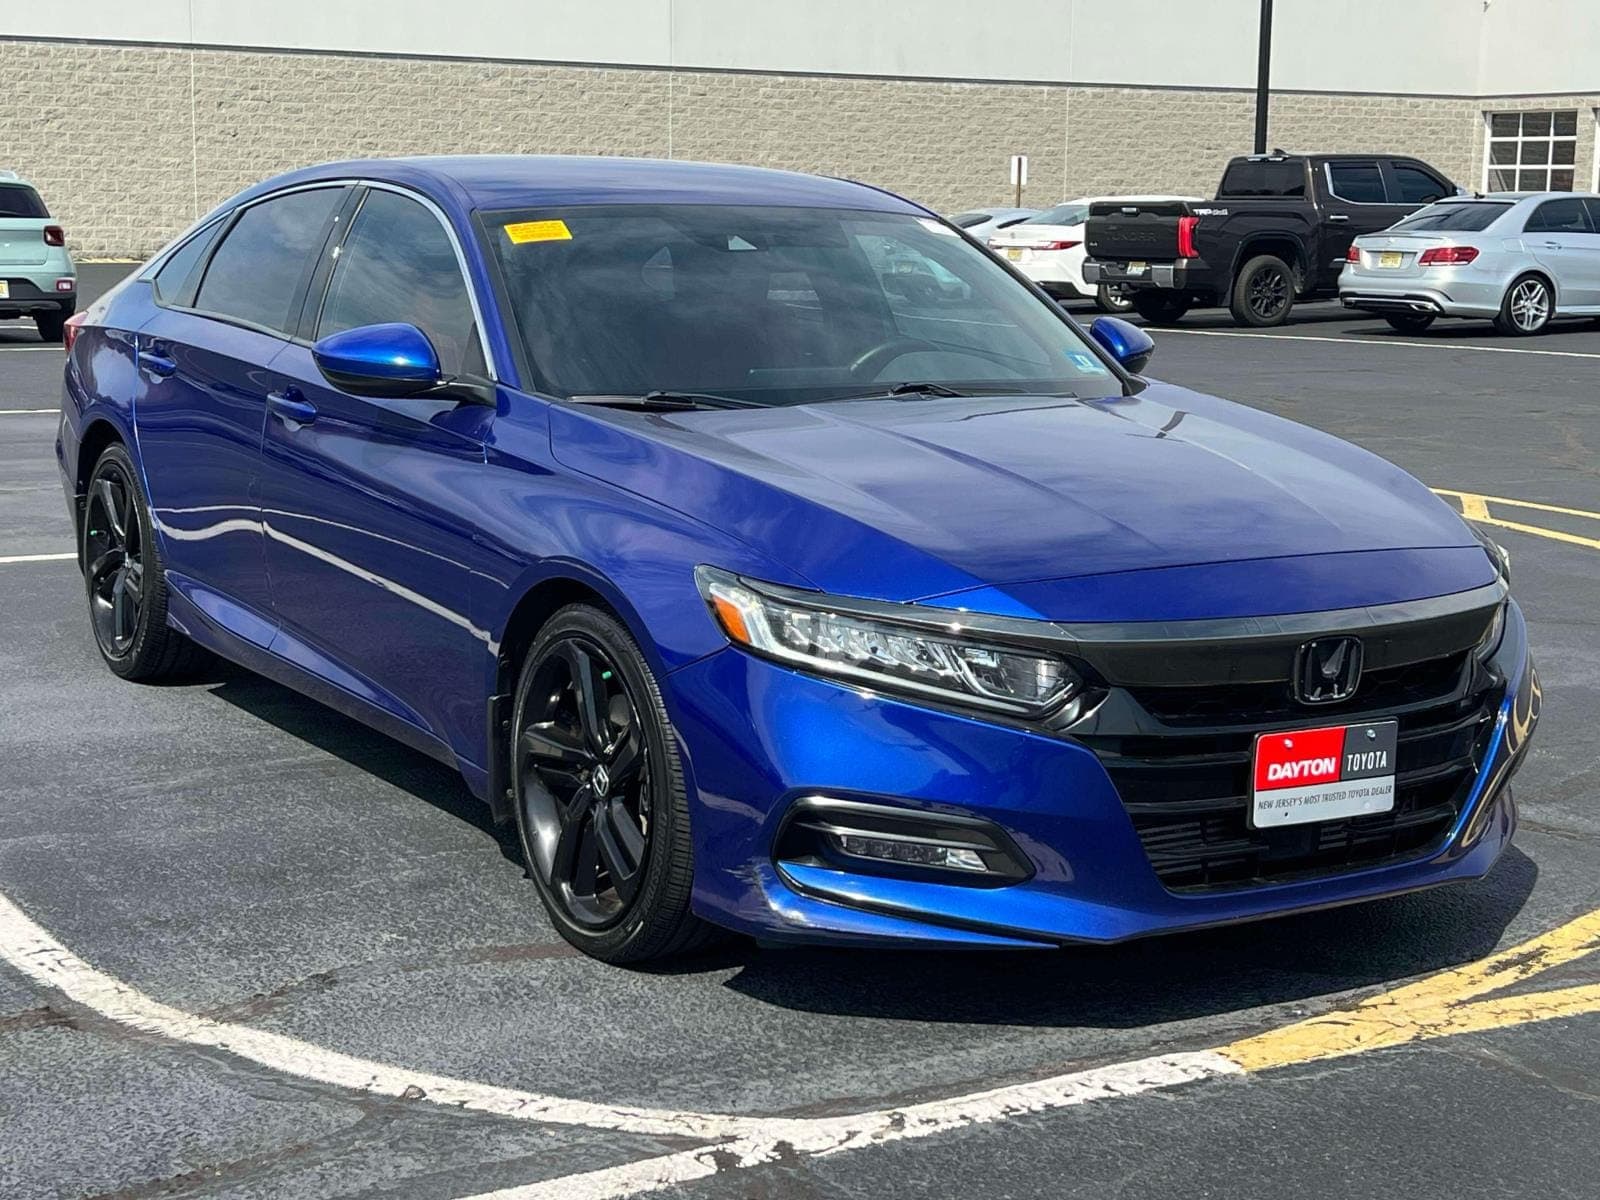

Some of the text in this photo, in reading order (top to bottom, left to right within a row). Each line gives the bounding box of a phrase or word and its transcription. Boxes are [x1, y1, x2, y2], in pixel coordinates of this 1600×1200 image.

[1267, 750, 1388, 781] DAYTON TOYOTA
[1258, 784, 1392, 810] NEW JERSEY'S MOST TRUSTED TOYOTA DEALER
